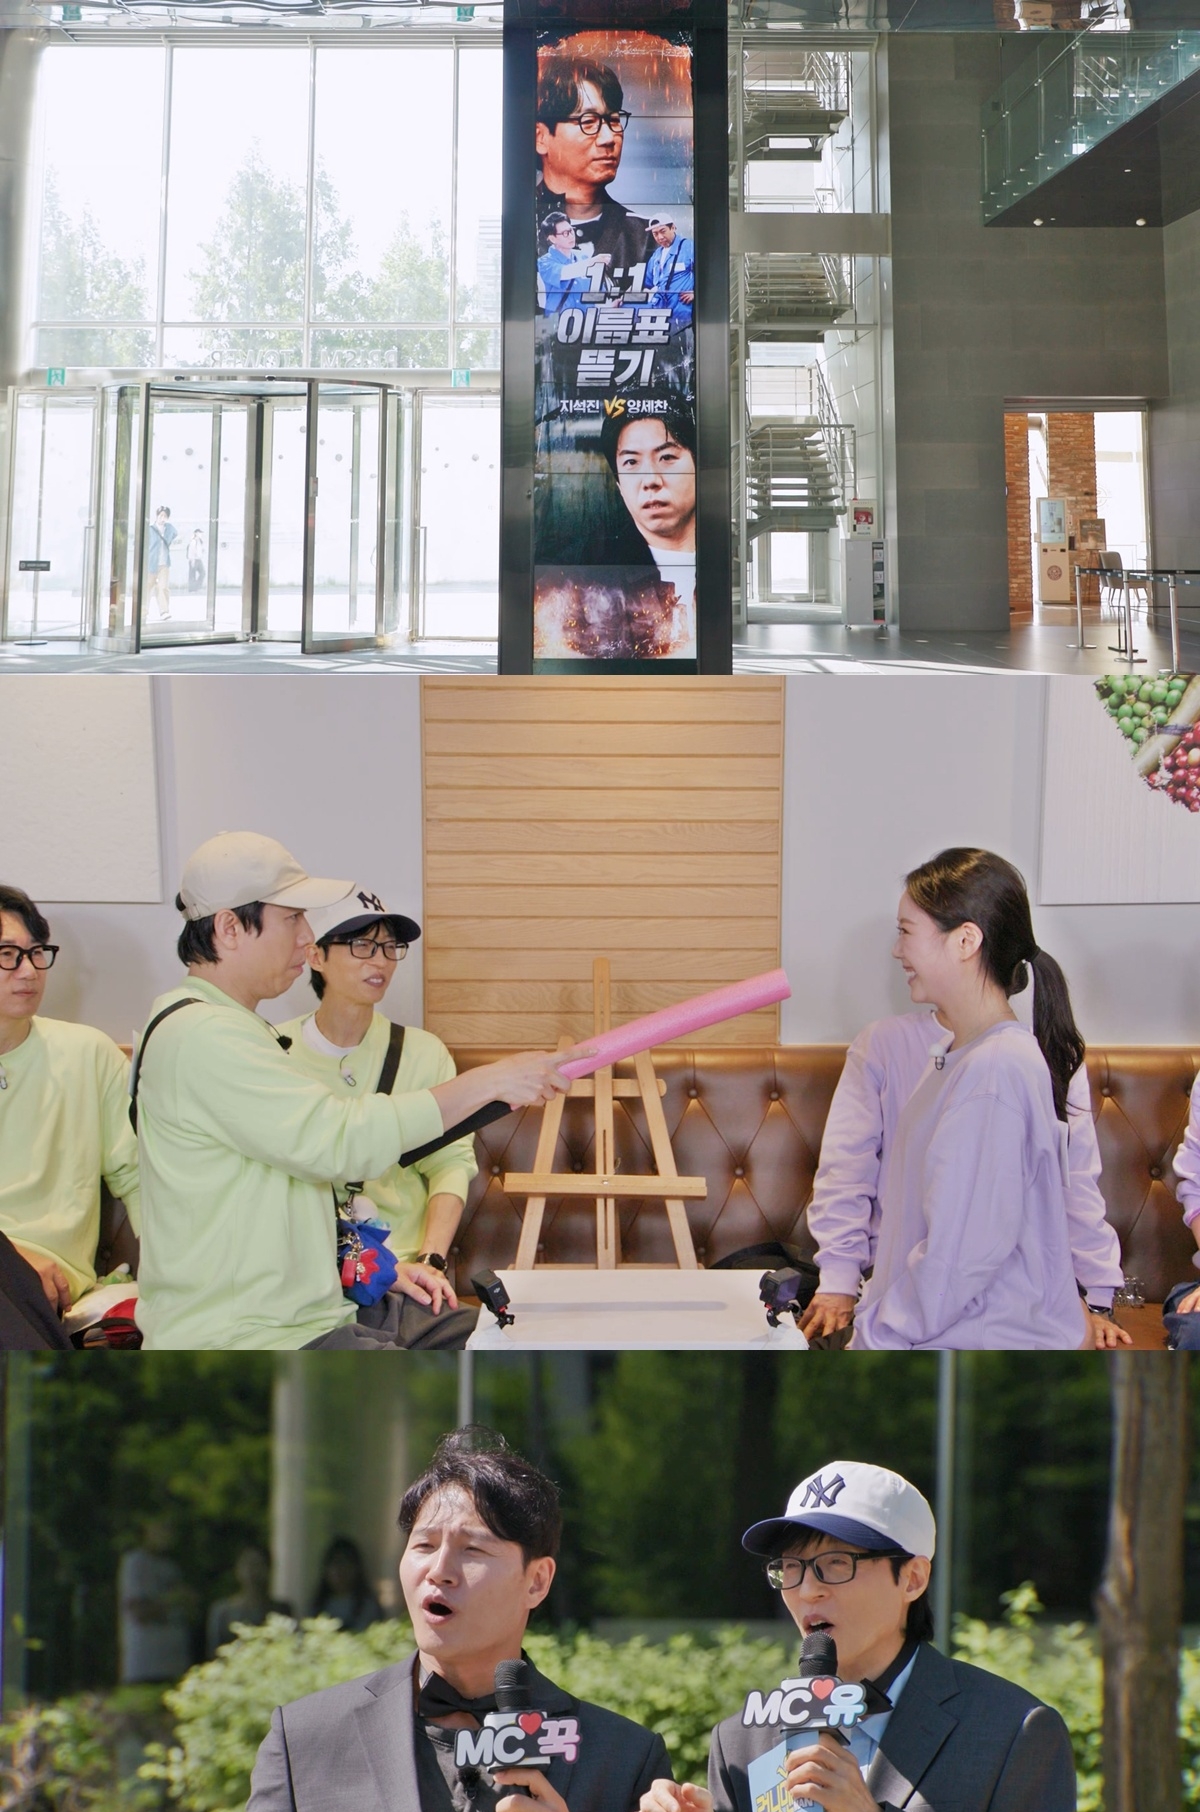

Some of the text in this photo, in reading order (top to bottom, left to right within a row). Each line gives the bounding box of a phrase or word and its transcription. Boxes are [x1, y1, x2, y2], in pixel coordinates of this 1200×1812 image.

[581, 262, 650, 302] 1:1
[557, 307, 672, 344] 이름표
[576, 349, 655, 387] 뜯기
[560, 395, 669, 418] 지석진 VS 양세찬
[800, 1473, 846, 1508] NY
[743, 1683, 865, 1726] MC 유
[456, 1718, 581, 1767] MC 꾹
